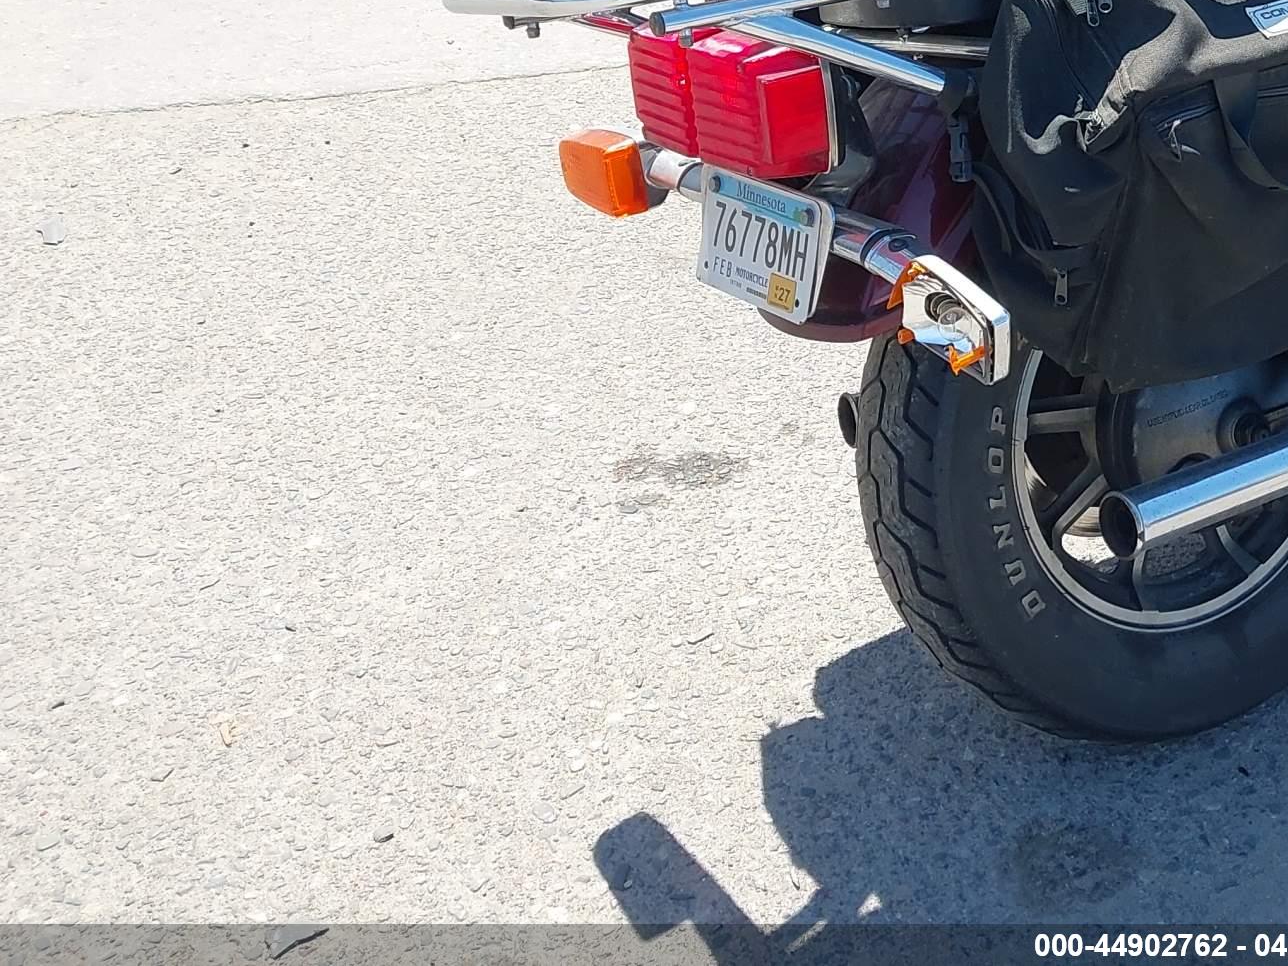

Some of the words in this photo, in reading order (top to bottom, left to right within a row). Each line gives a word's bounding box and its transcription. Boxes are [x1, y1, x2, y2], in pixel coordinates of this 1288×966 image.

[736, 180, 786, 213] Minnesota
[713, 201, 809, 282] 76778MH
[713, 256, 733, 278] FEB
[735, 267, 769, 288] MOTORCYCLE
[778, 286, 791, 304] 27
[987, 406, 1047, 619] DUNLOP
